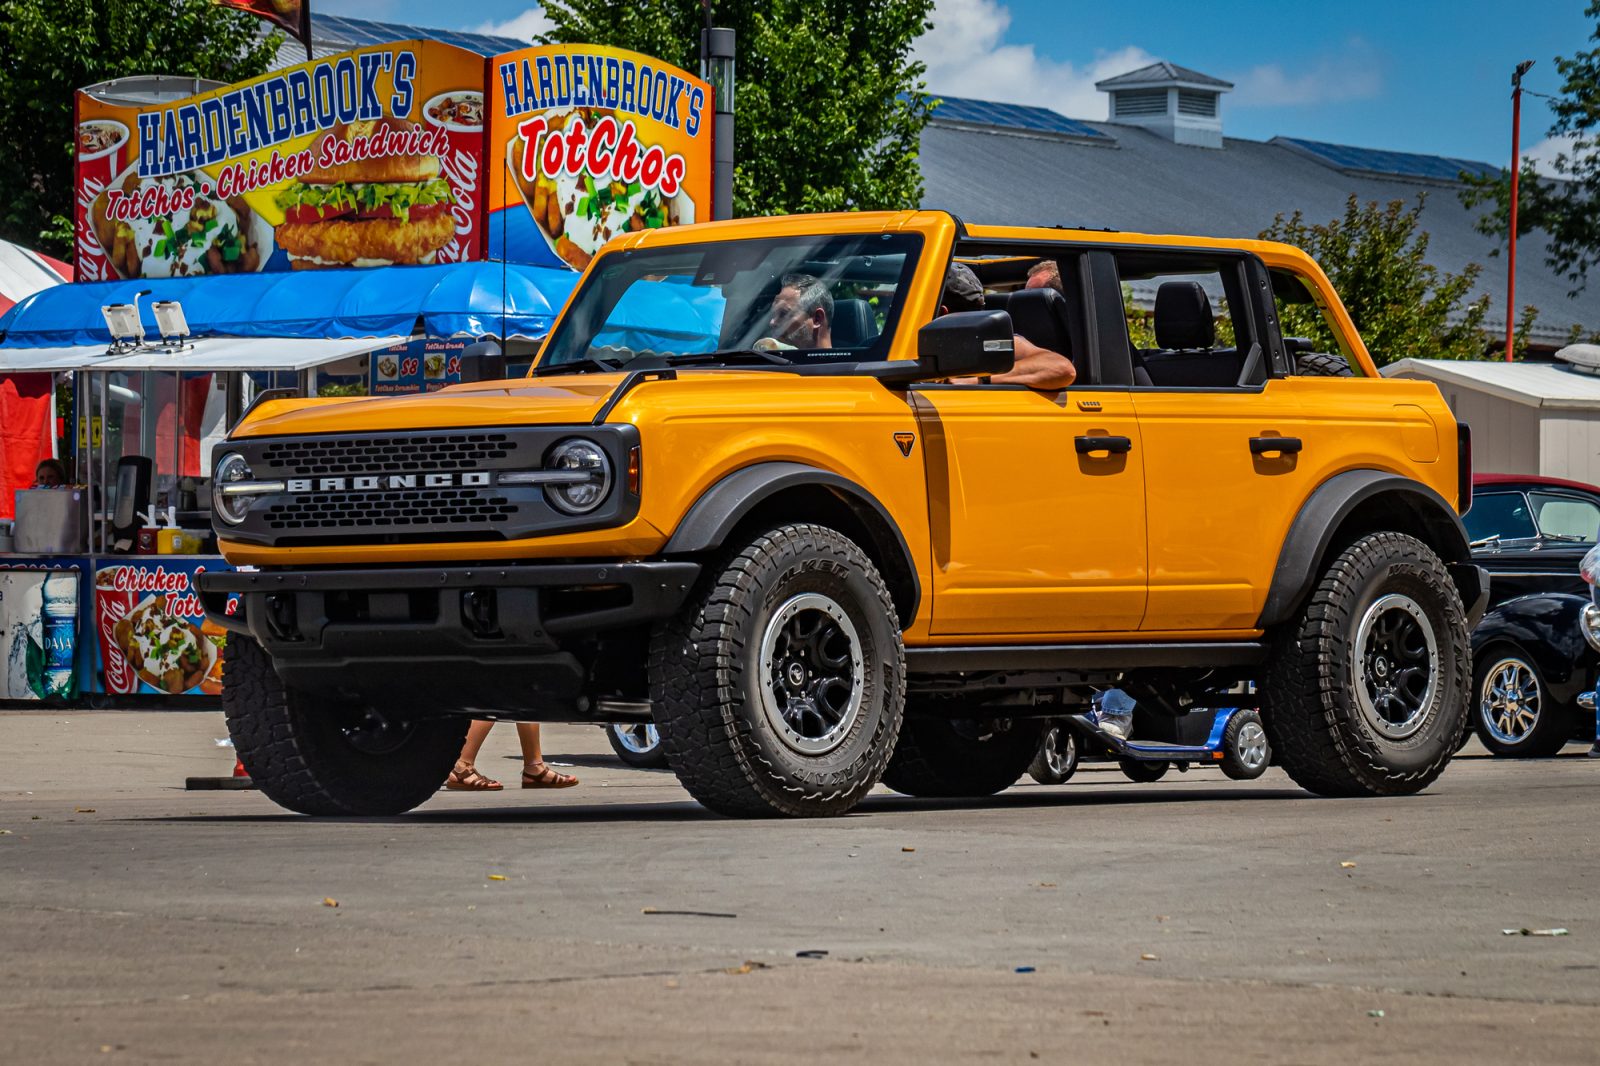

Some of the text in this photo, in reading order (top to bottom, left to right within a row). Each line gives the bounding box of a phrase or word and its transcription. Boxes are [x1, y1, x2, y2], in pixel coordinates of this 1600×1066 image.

[138, 51, 417, 178] HARDENBROOK'S
[500, 55, 705, 137] HARDENBROOK'S
[106, 123, 449, 221] TotChos Chicken Sandwich
[518, 115, 685, 198] TotChos
[287, 472, 490, 492] BRONCO
[114, 565, 189, 592] Chicken
[762, 559, 849, 609] FALKEN
